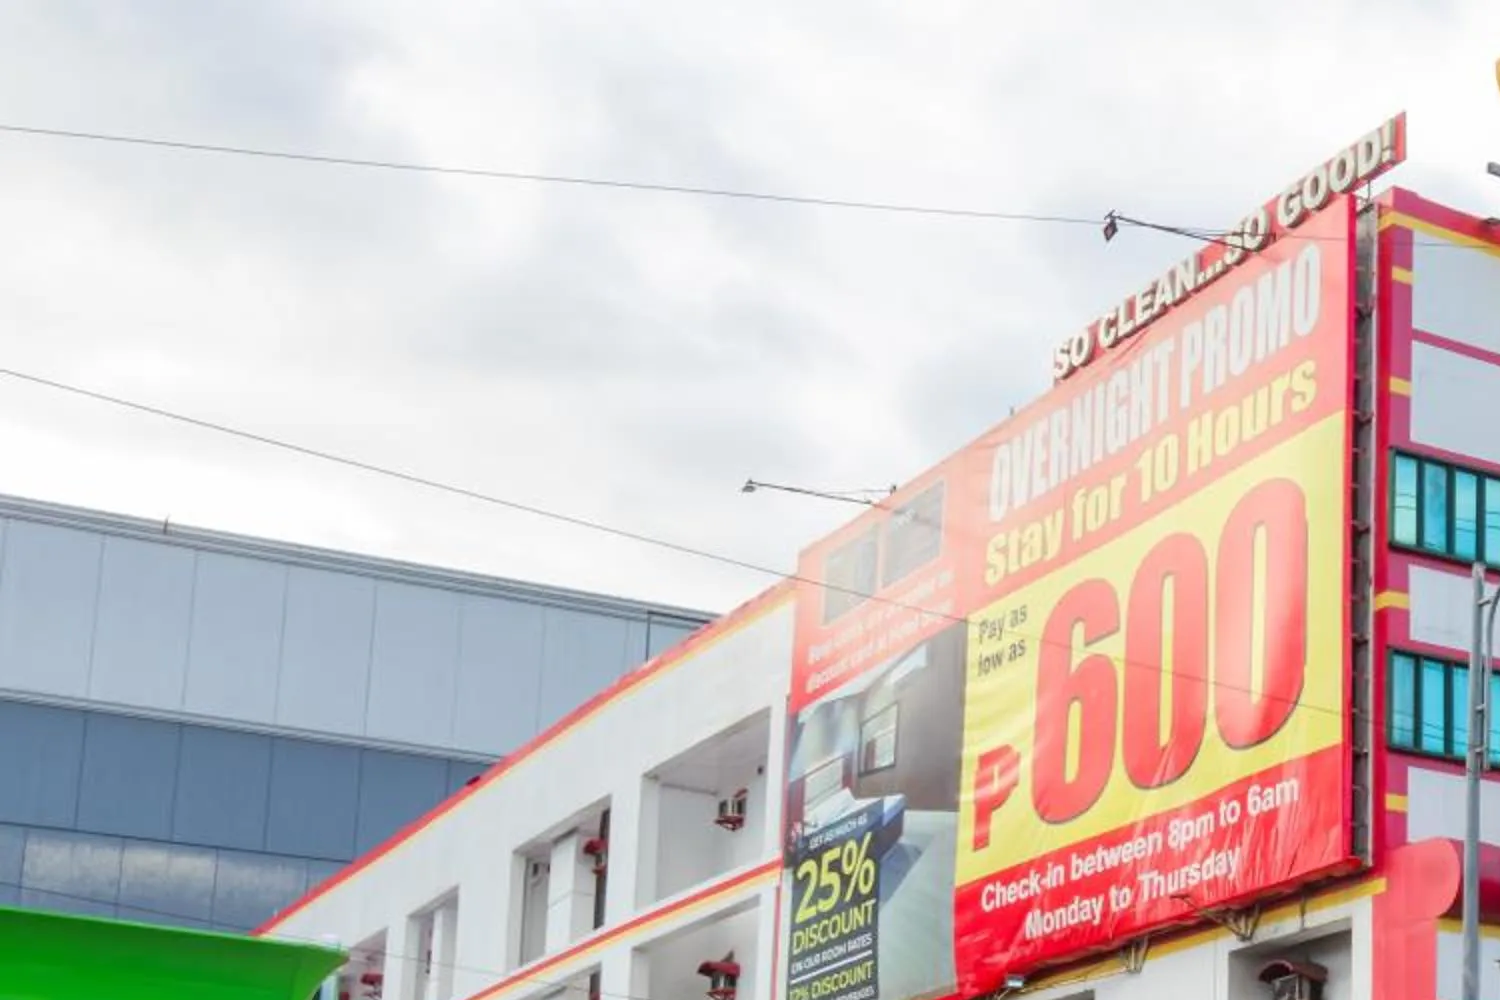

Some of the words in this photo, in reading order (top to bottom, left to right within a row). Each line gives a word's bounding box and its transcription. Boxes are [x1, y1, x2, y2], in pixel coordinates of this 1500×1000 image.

[1052, 334, 1093, 380] SO
[1276, 117, 1397, 230] GOOD!
[990, 343, 1174, 522] OVERNIGHT
[1181, 244, 1320, 400] PROMO
[985, 518, 1066, 585] Stay
[1071, 474, 1130, 541] for
[1135, 431, 1179, 502] 10
[1186, 359, 1318, 469] Hours
[976, 649, 1007, 679] low
[1009, 638, 1027, 663] as
[977, 613, 1006, 649] Pay
[1009, 602, 1029, 629] as
[1031, 476, 1308, 825] 600
[795, 831, 876, 924] 25%
[980, 853, 1065, 914] Check-in
[1069, 831, 1163, 888] between
[1167, 812, 1216, 859] 8pm
[1219, 797, 1242, 828] to
[1246, 776, 1299, 817] 6am
[1025, 886, 1106, 942] Monday
[1109, 880, 1132, 911] to
[1139, 842, 1241, 900] Thursday
[792, 898, 876, 955] DISCOUNT
[811, 960, 875, 999] DISCOUNT
